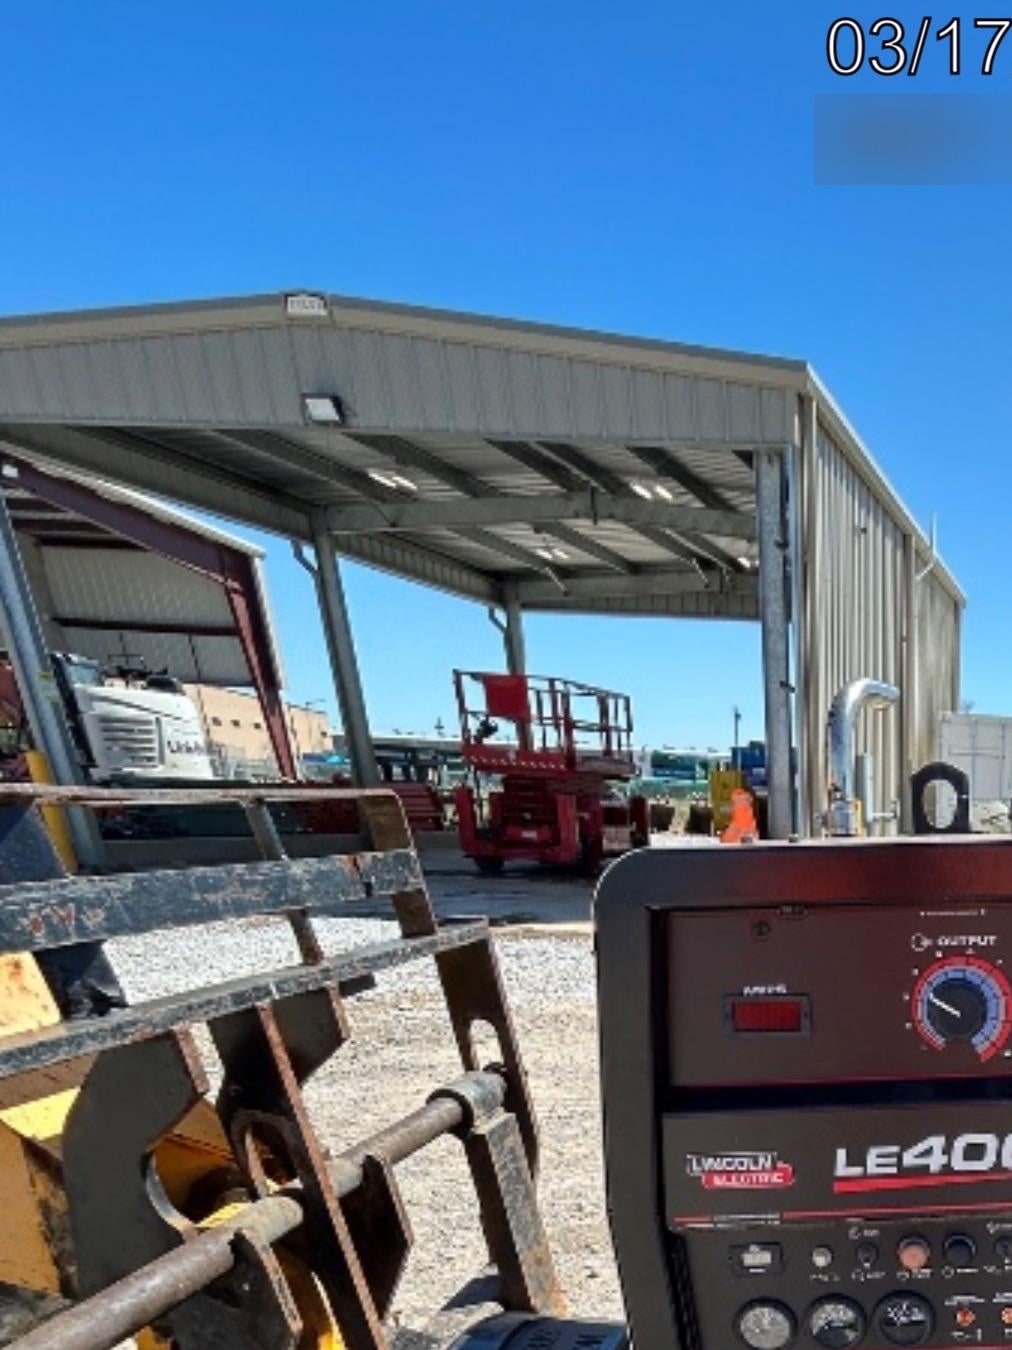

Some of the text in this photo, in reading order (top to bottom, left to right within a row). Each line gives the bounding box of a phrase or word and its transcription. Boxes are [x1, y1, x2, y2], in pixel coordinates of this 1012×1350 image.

[937, 935, 998, 946] OUTPUT
[692, 1154, 772, 1171] LINCOLN
[713, 1172, 785, 1185] ELECTRIC
